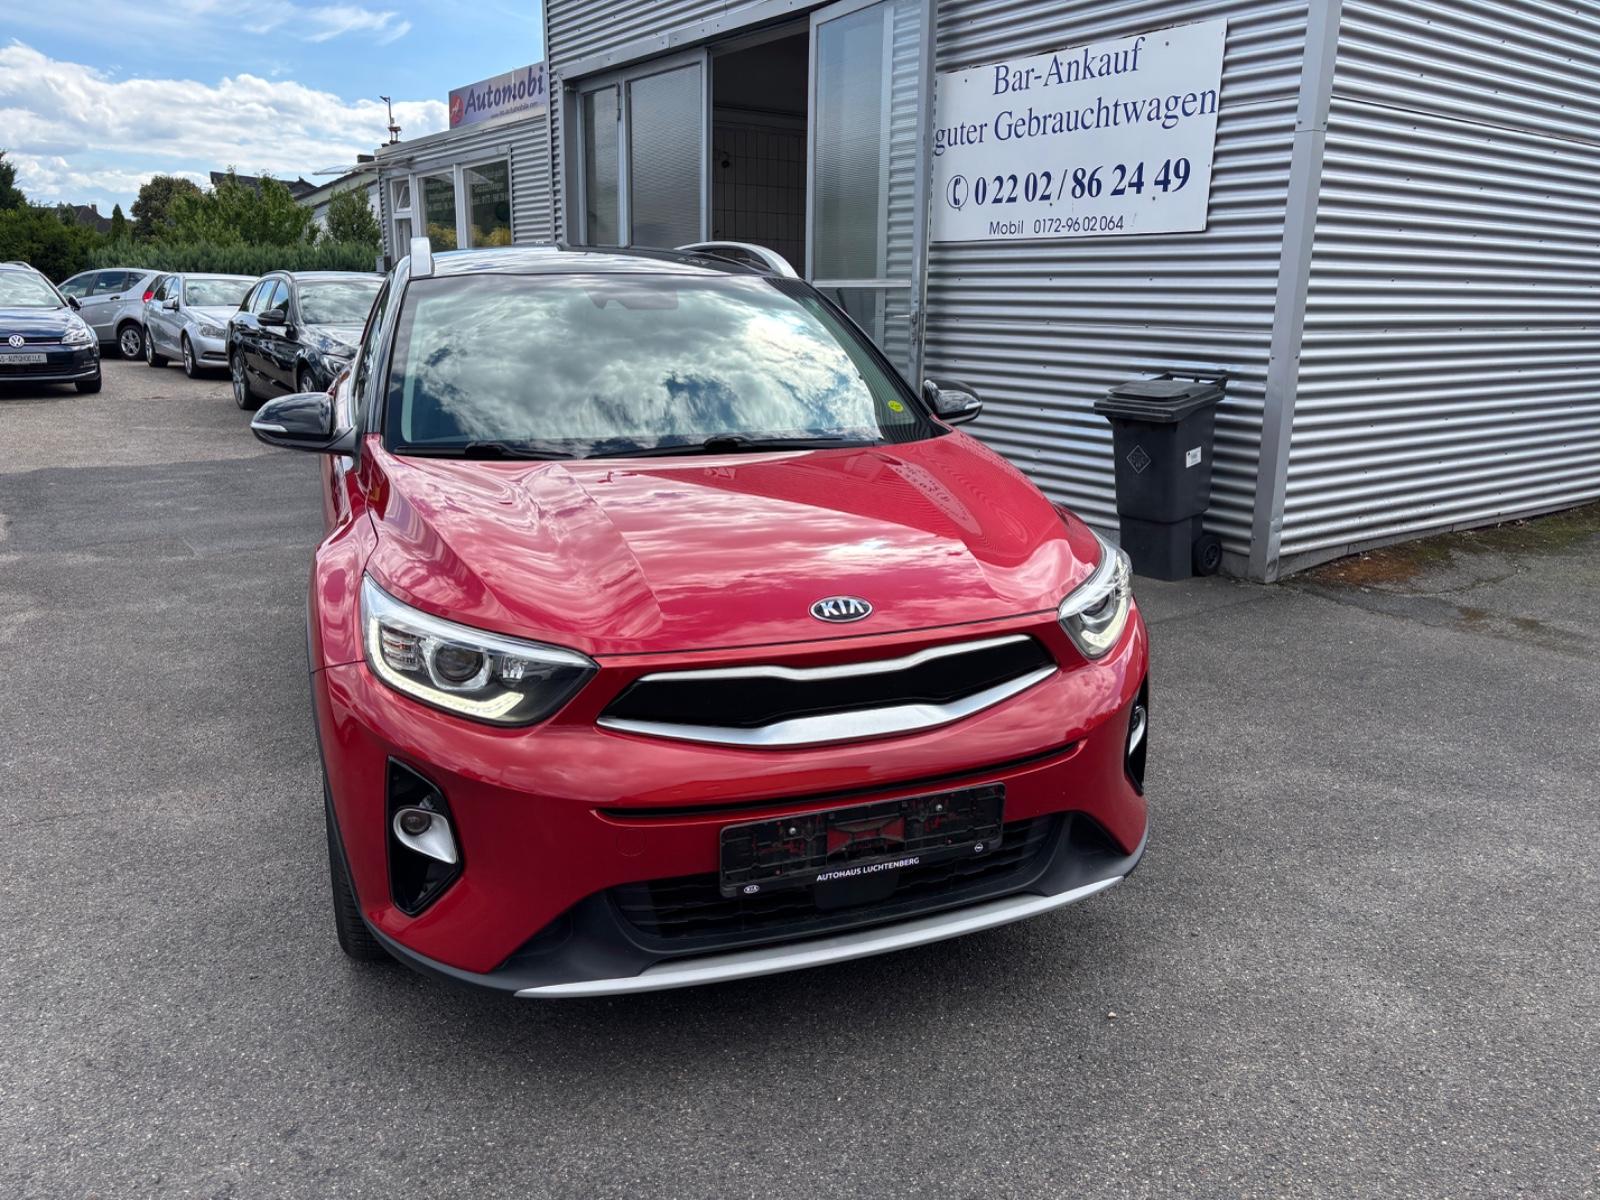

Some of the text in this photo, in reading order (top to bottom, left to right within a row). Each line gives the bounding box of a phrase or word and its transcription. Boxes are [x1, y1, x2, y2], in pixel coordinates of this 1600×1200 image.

[992, 36, 1145, 95] Bar-Ankauf
[933, 88, 1217, 157] guter Gebrauchtwagen
[989, 220, 1024, 235] Mobil
[820, 599, 865, 617] KIA
[816, 857, 920, 881] AUTOHAUS LUCHTENBERG
[745, 885, 759, 893] KIA
